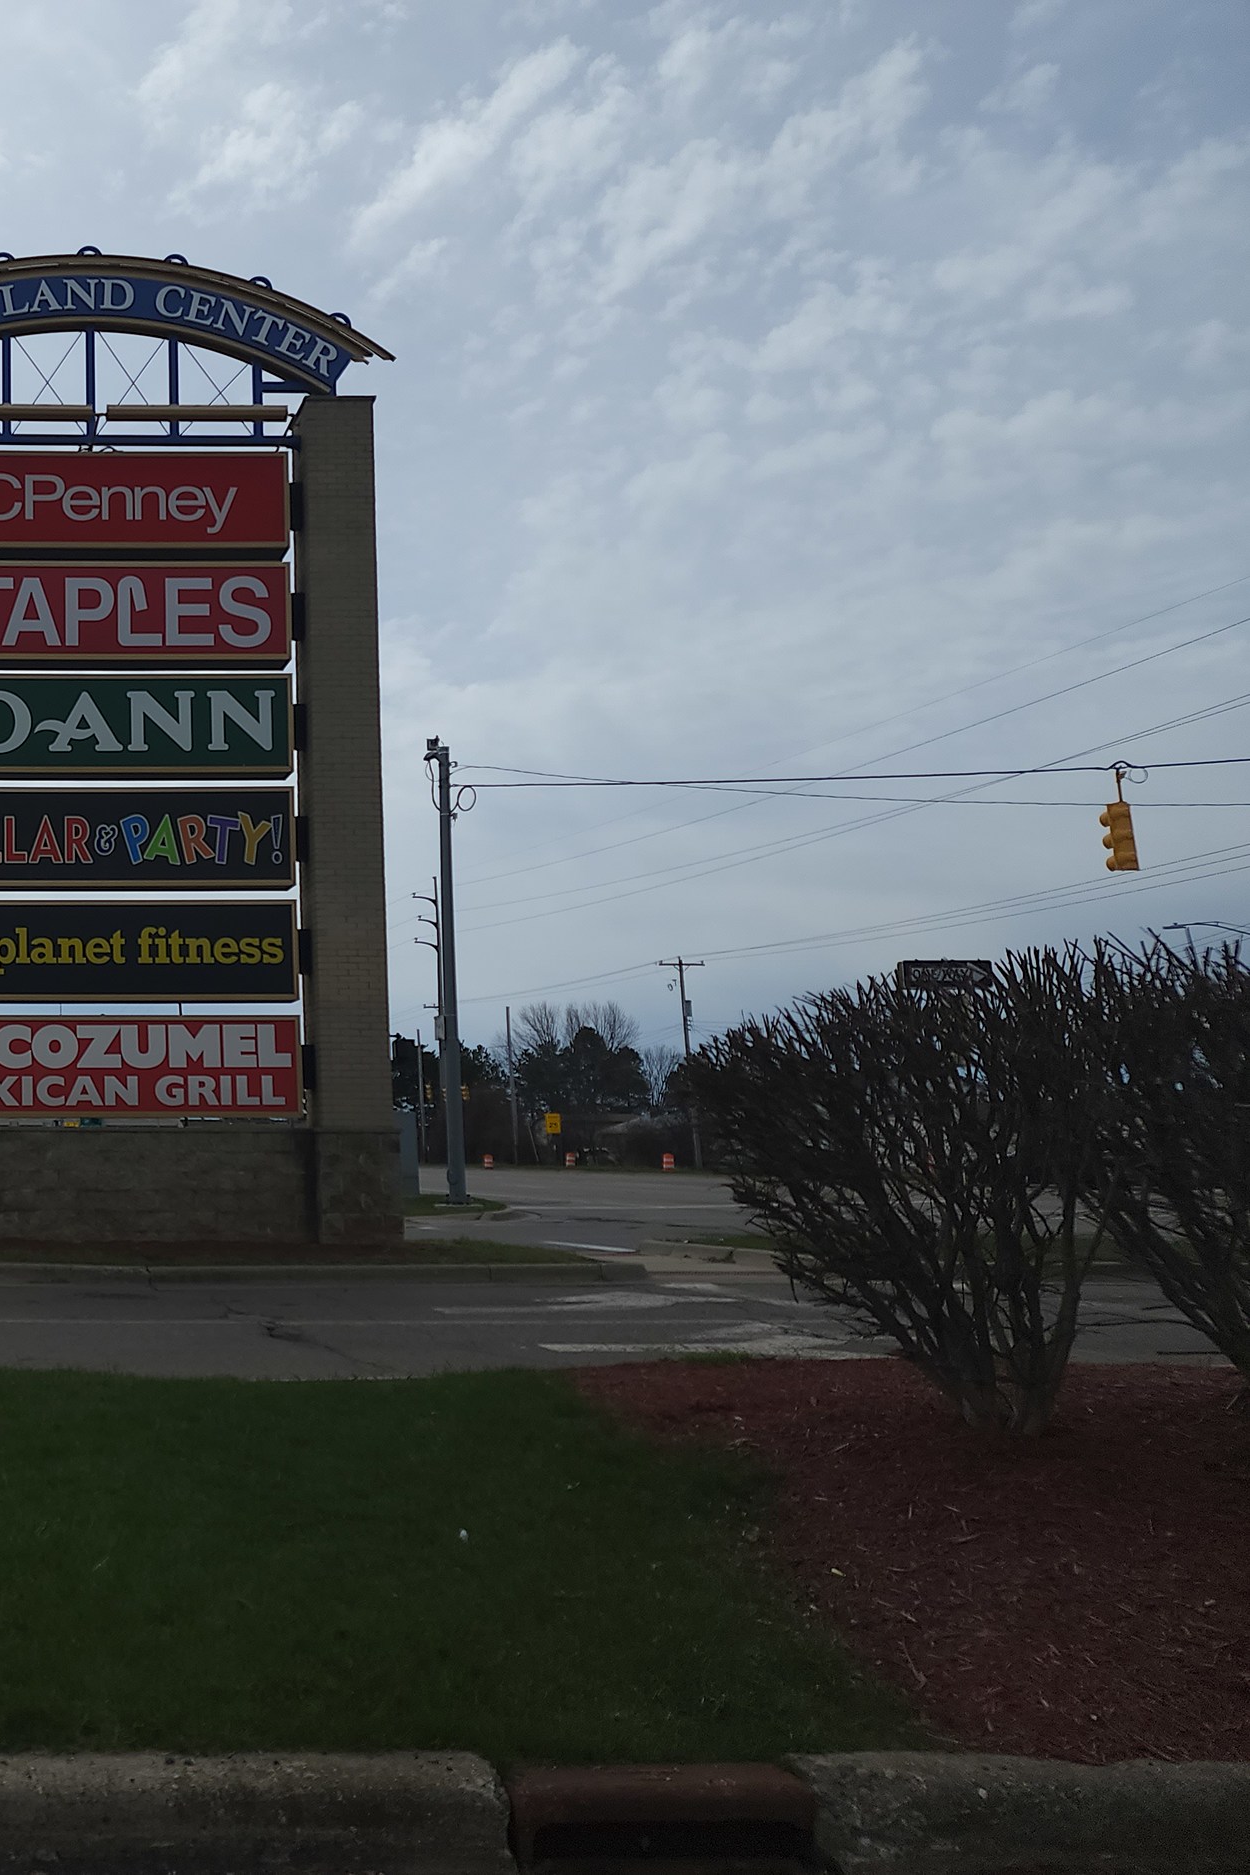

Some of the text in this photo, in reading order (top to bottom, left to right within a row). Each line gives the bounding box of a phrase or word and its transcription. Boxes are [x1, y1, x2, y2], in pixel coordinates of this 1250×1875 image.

[155, 285, 338, 378] CENTER
[94, 824, 117, 855] &
[121, 810, 284, 865] PARTY!
[138, 926, 285, 965] fitness
[154, 1075, 286, 1107] GRILL
